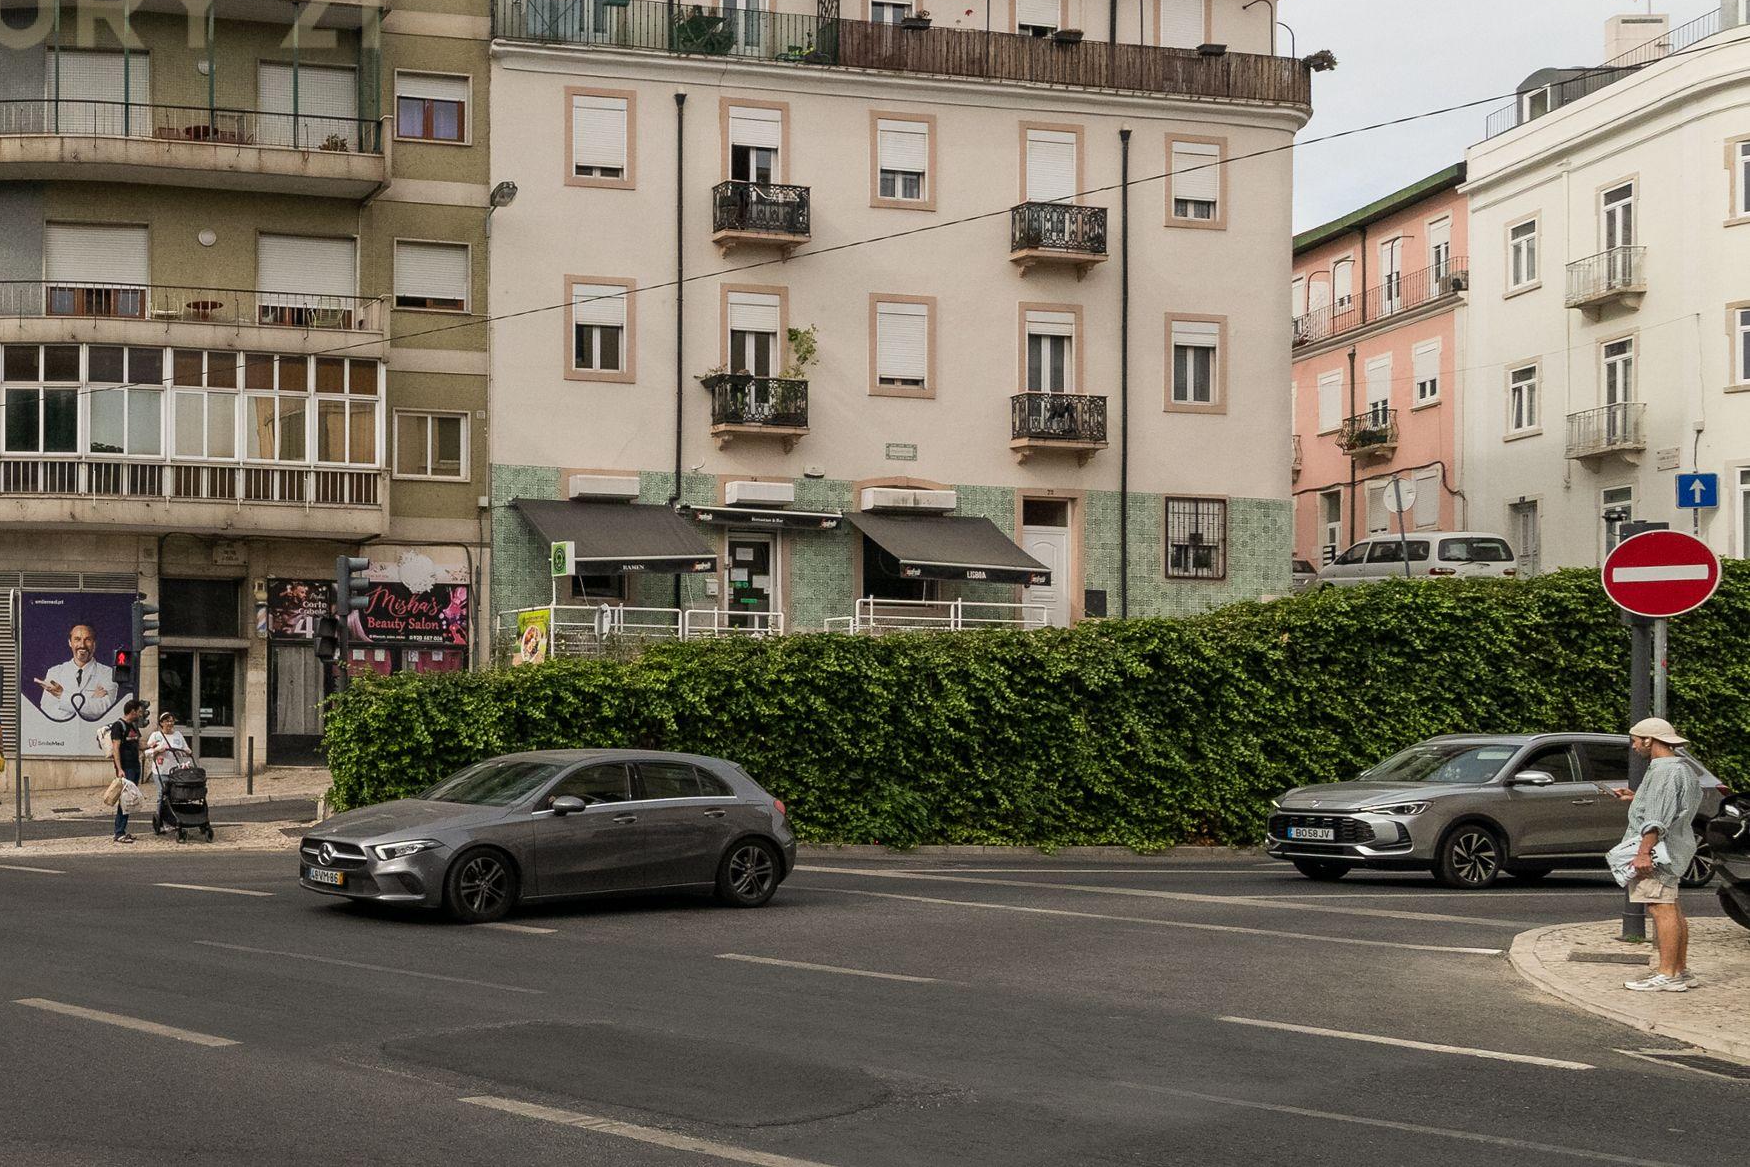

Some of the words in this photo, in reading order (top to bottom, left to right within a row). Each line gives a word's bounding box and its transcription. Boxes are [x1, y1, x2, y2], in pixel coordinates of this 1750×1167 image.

[967, 571, 987, 579] LISBOA
[367, 617, 405, 632] Beauty
[409, 617, 439, 630] Salon
